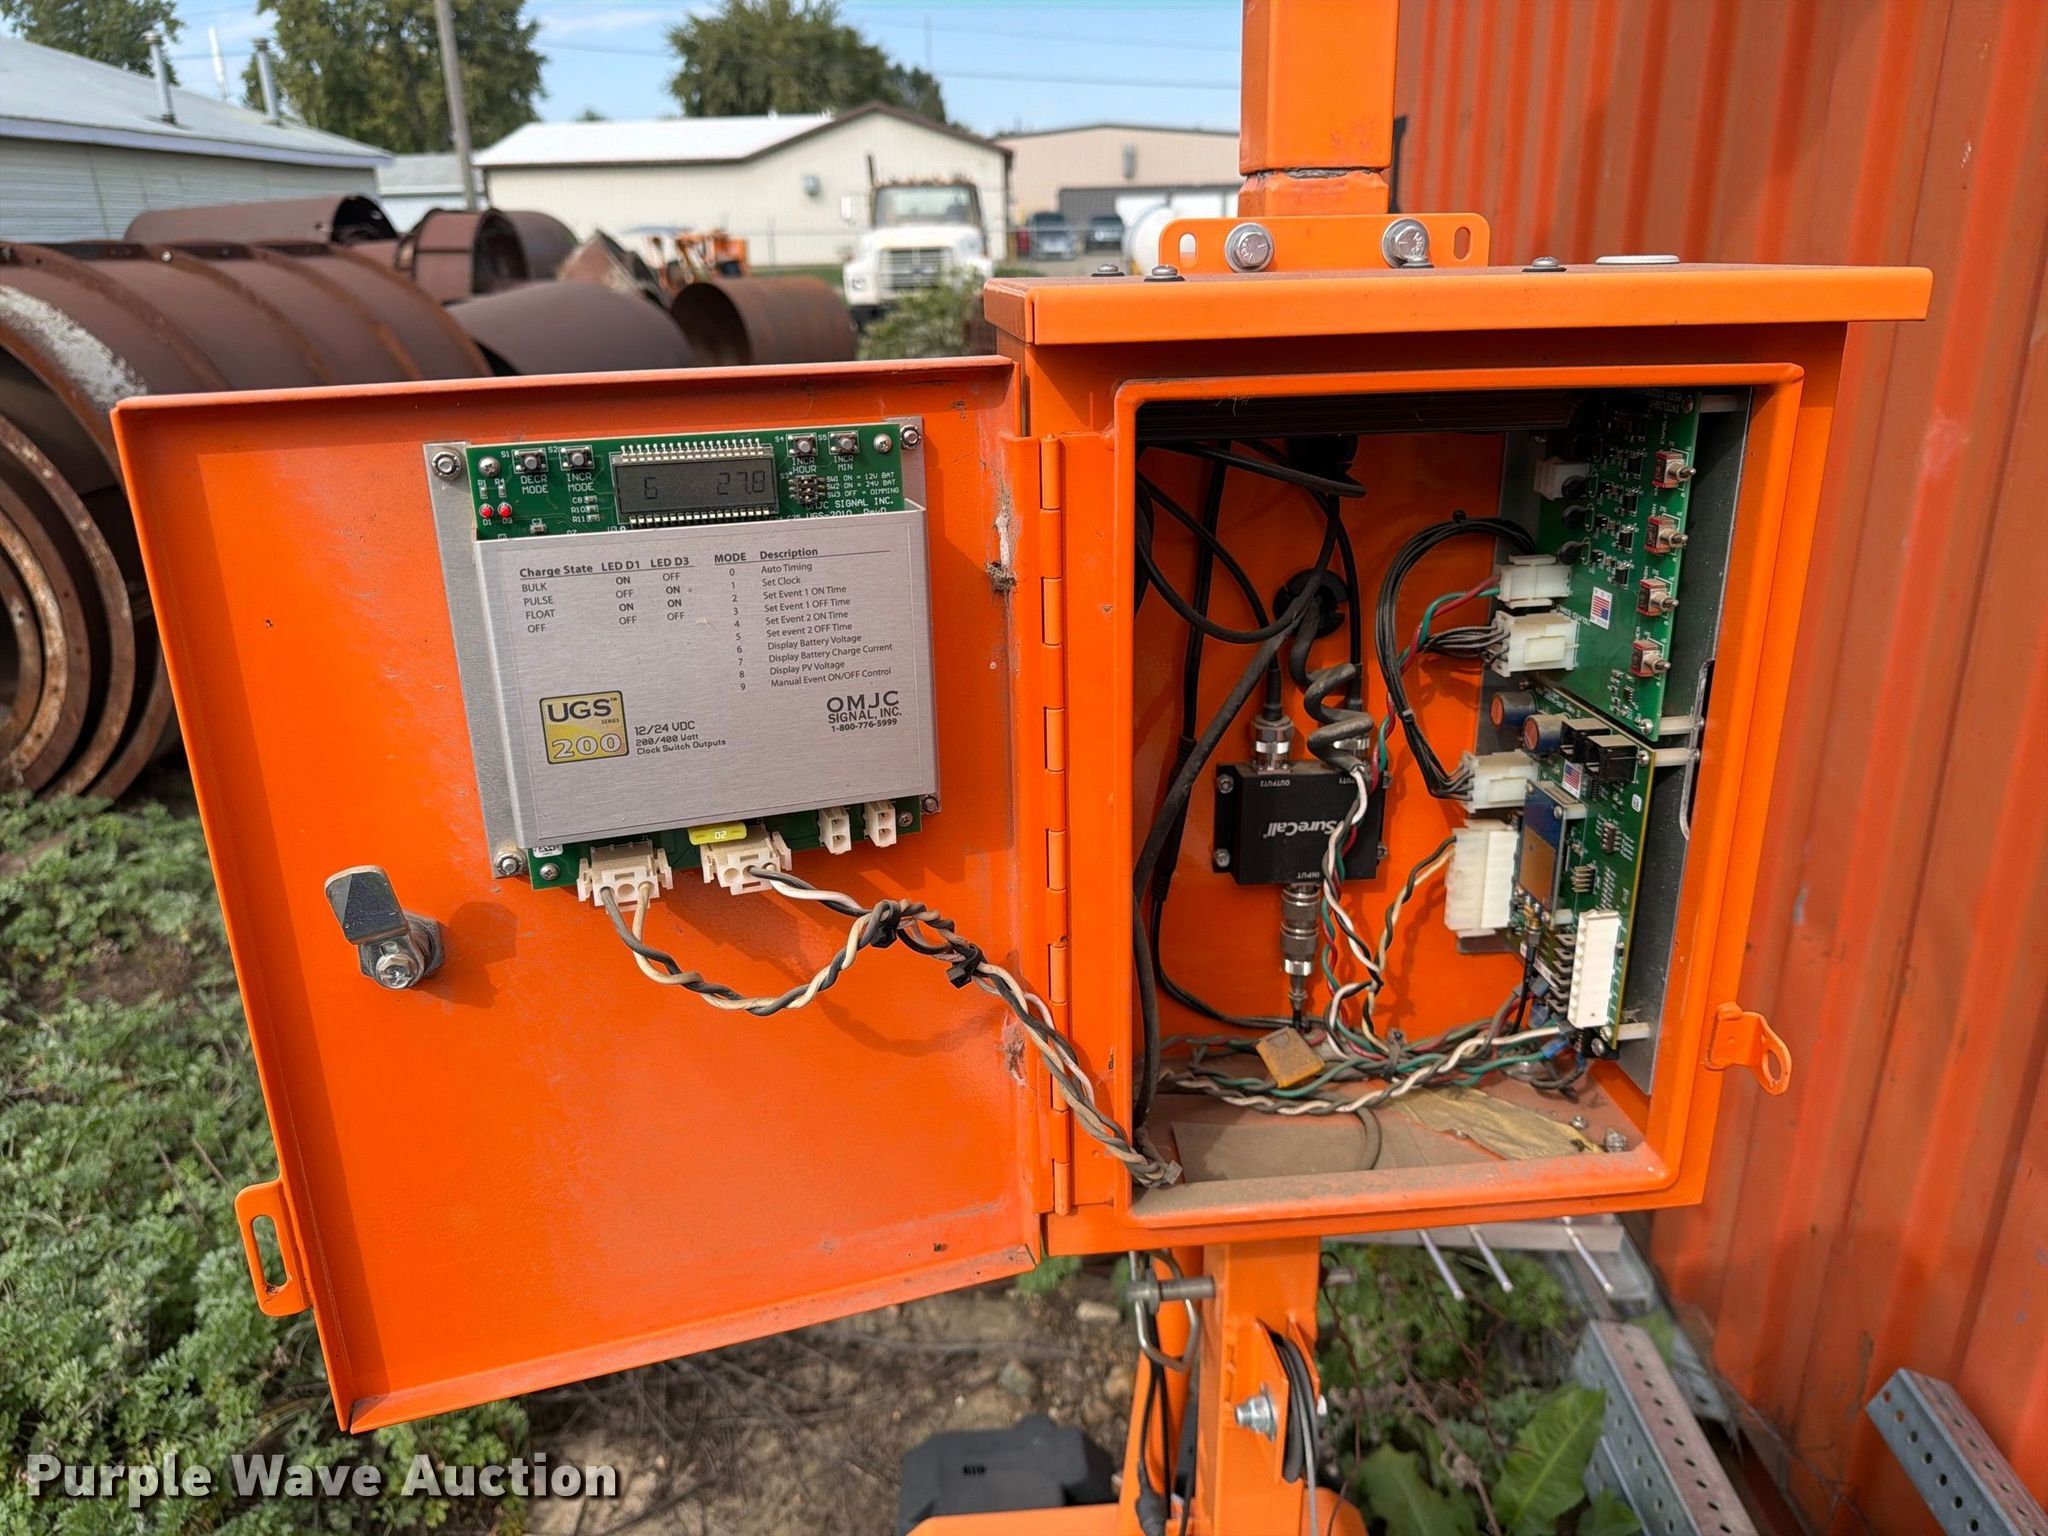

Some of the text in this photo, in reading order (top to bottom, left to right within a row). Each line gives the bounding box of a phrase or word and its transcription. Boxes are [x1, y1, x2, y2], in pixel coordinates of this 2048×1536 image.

[791, 457, 815, 466] INCR
[833, 455, 854, 463] INCR
[837, 463, 853, 471] MIN
[566, 473, 593, 483] INCR
[792, 465, 817, 474] HOUR
[520, 474, 548, 485] DECR
[568, 482, 595, 492] MODE
[644, 476, 658, 500] 6
[522, 484, 549, 495] MODE
[870, 487, 900, 495] DIMMING
[835, 499, 868, 508] SIGNAL
[874, 496, 894, 505] INC.
[714, 547, 818, 564] MODE Description
[519, 557, 690, 578] Charge State LED D1 LED D3
[761, 564, 782, 574] Auto
[783, 562, 813, 573] Timing
[522, 572, 681, 593] BULK ON OFF
[762, 578, 776, 587] Set
[777, 576, 801, 586] Clock
[523, 585, 681, 606] PULSE OFF ON
[731, 594, 738, 603] 2
[763, 591, 777, 600] Set
[778, 589, 803, 599] Event
[811, 587, 825, 596] ON
[826, 585, 847, 595] Time
[525, 599, 682, 620] FLOAT ON ON
[733, 607, 739, 616] 3
[764, 604, 778, 613] Set
[779, 602, 804, 612] Event
[812, 599, 829, 608] OFF
[830, 597, 851, 607] Time
[527, 612, 686, 634] OFF OFF OFF
[734, 610, 849, 628] 4 Set Event 2 ON Time
[736, 622, 852, 641] 5 Set event 2 OFF Time
[737, 634, 862, 654] 6 Display Battery Voltage
[738, 643, 893, 666] 7 Display Battery Charge Current
[739, 660, 845, 679] 8 Display PV Voltage
[740, 667, 892, 691] 9 Manual Event ON/OFF Control
[826, 690, 900, 713] OMJC
[547, 699, 612, 723] UGS
[828, 706, 902, 724] SIGNAL, INC.
[634, 720, 695, 736] 12/24 VDC
[831, 718, 898, 732] 1-800-776-5999
[551, 733, 622, 759] 200
[635, 733, 699, 747] 200/400 Watt
[637, 739, 726, 756] Clock Switch Outputs
[1260, 779, 1290, 787] OUTPUT2
[1266, 820, 1337, 837] SureCall
[1296, 871, 1320, 879] INPUT
